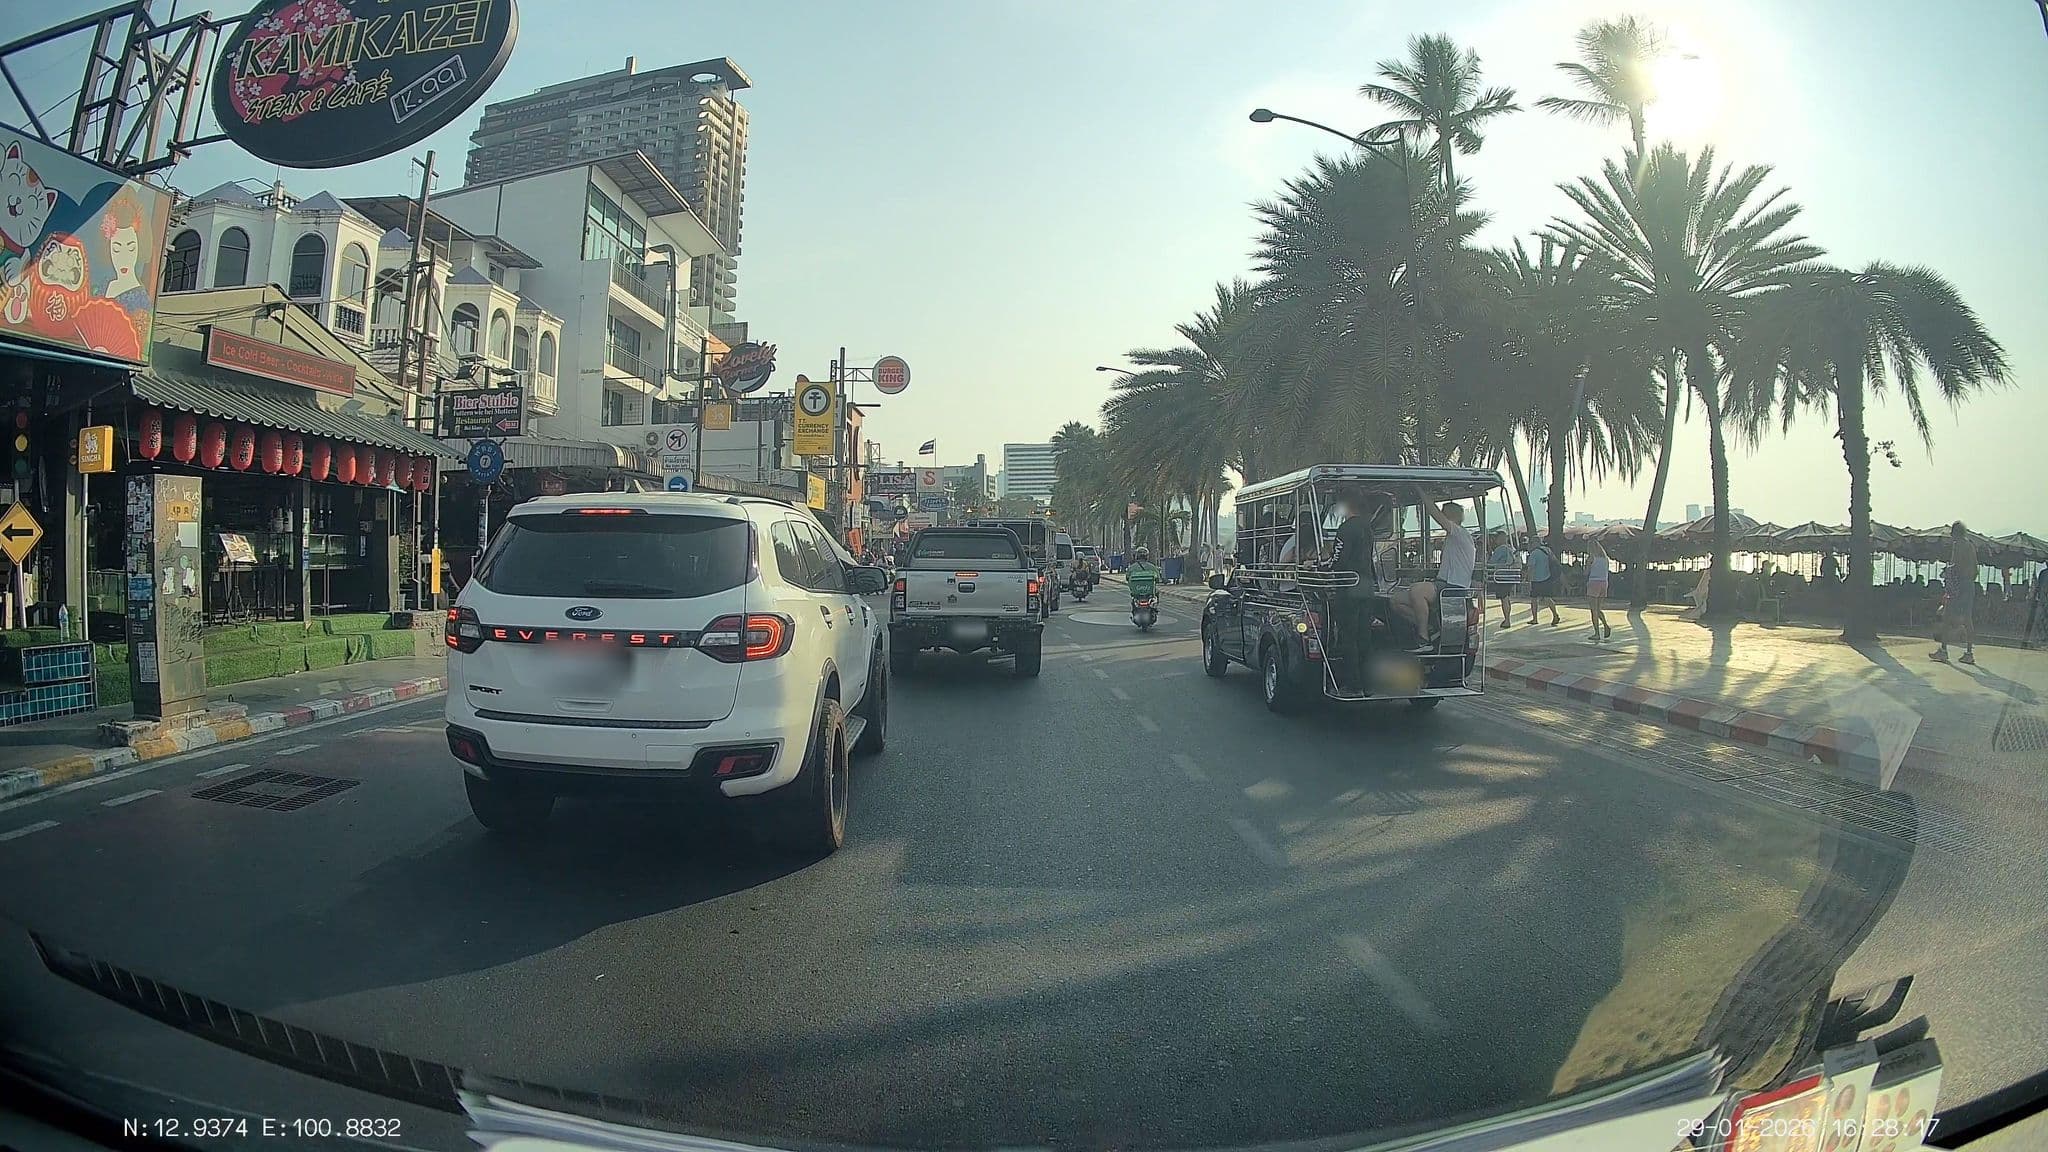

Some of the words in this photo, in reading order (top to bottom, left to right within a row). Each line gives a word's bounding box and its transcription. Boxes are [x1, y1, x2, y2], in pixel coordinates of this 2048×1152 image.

[244, 91, 311, 123] STEAK
[309, 89, 322, 112] &
[327, 69, 392, 109] CAFÉ
[223, 342, 236, 356] Ice
[238, 346, 258, 360] Cold
[260, 352, 280, 367] Beer
[877, 374, 905, 383] KING
[453, 395, 479, 410] Bier
[455, 416, 493, 425] Restaurant
[81, 454, 101, 463] SINGHA
[571, 606, 593, 617] Ford
[494, 629, 675, 645] EVEREST
[469, 684, 503, 695] SPORT
